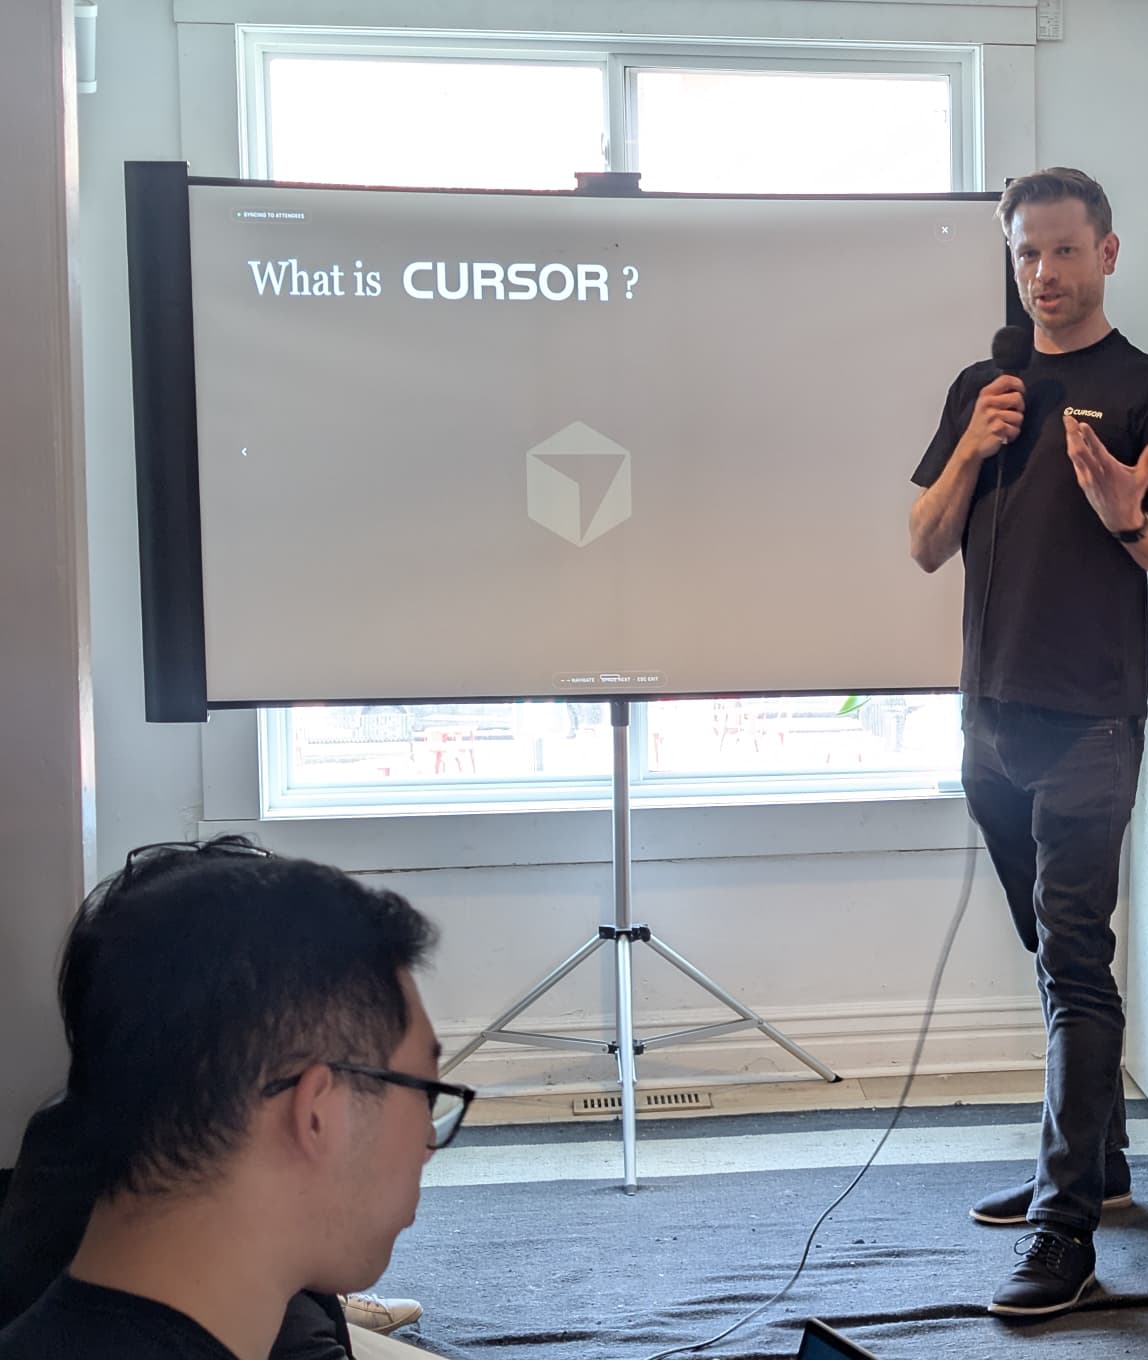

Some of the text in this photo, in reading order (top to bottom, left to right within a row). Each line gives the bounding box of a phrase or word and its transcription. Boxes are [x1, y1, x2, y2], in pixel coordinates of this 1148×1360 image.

[248, 258, 640, 302] What is CURSOR ?
[1073, 408, 1103, 419] CURSOR
